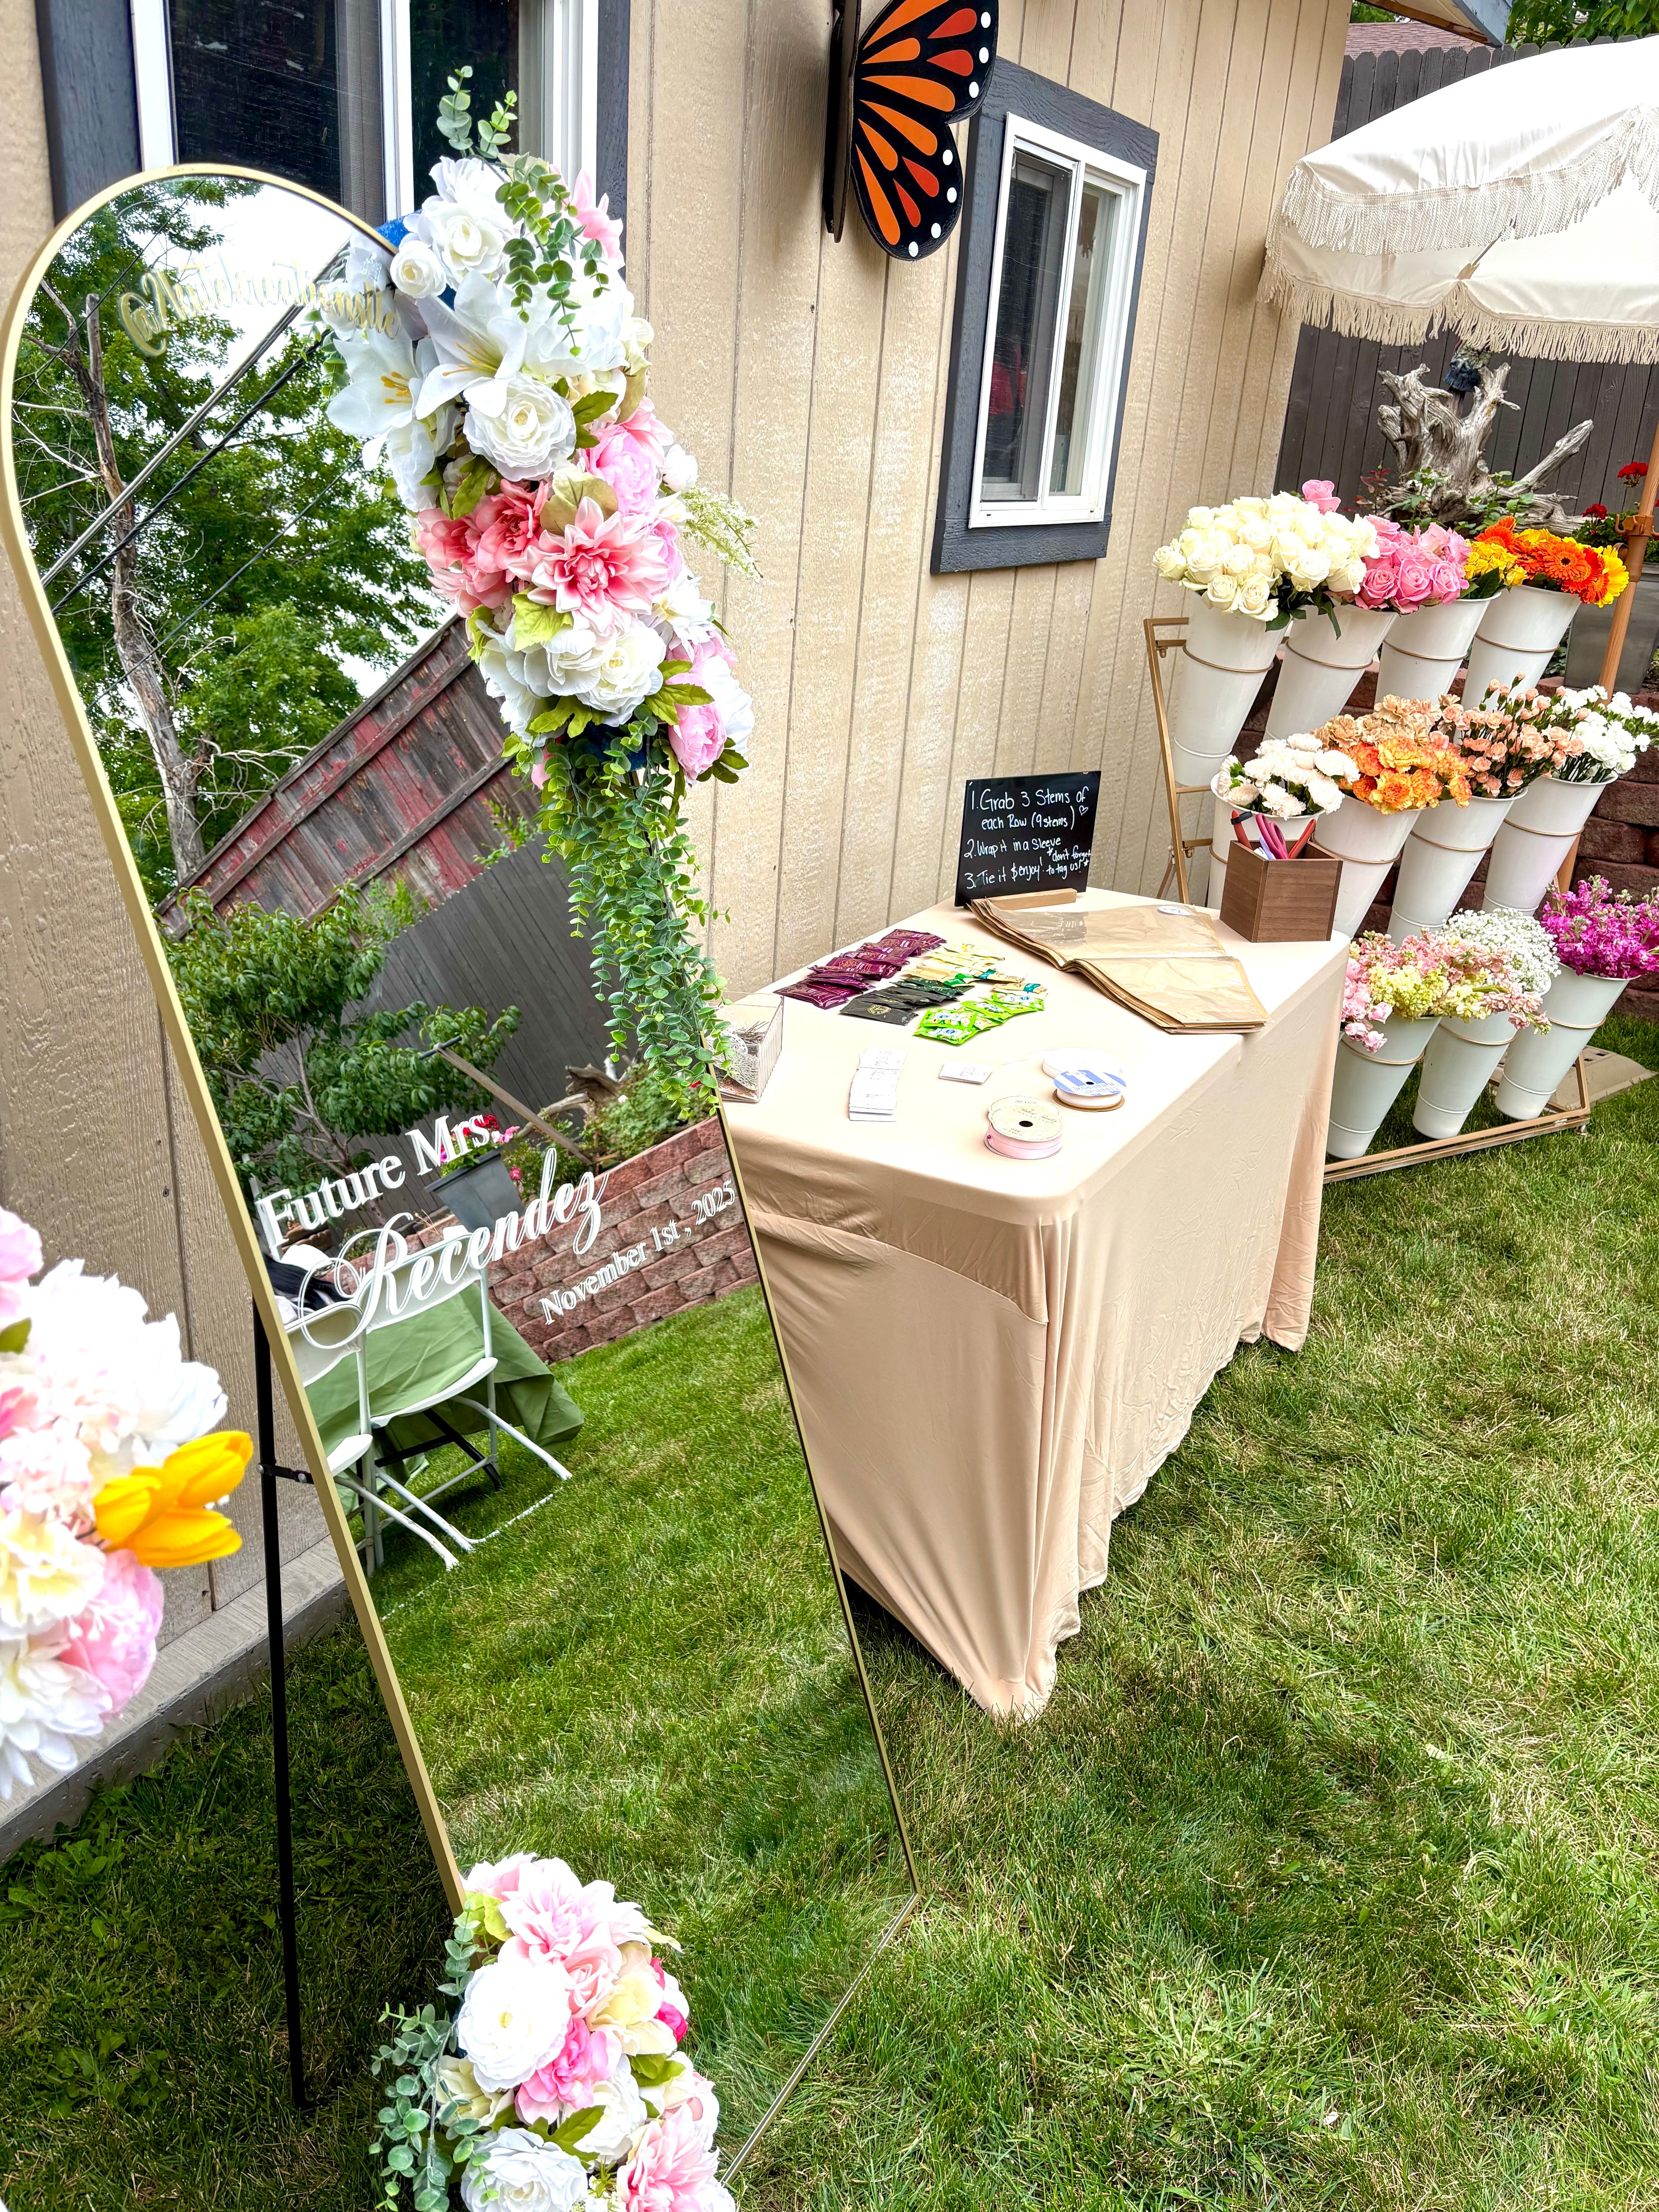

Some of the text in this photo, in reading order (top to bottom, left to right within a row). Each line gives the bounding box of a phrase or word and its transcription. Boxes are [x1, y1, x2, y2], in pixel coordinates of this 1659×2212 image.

[1020, 791, 1030, 807] 3
[1036, 788, 1070, 805] Stems
[1076, 786, 1089, 802] of
[981, 817, 1004, 830] each
[1007, 814, 1027, 828] Row
[998, 839, 1007, 852] it
[1071, 845, 1091, 861] forget
[998, 866, 1006, 882] it
[1046, 865, 1055, 875] to
[1055, 863, 1067, 880] tag
[255, 1114, 500, 1247] Future Mrs.
[297, 1147, 608, 1349] Recendez
[538, 1242, 648, 1325] November
[691, 1179, 735, 1226] 2025
